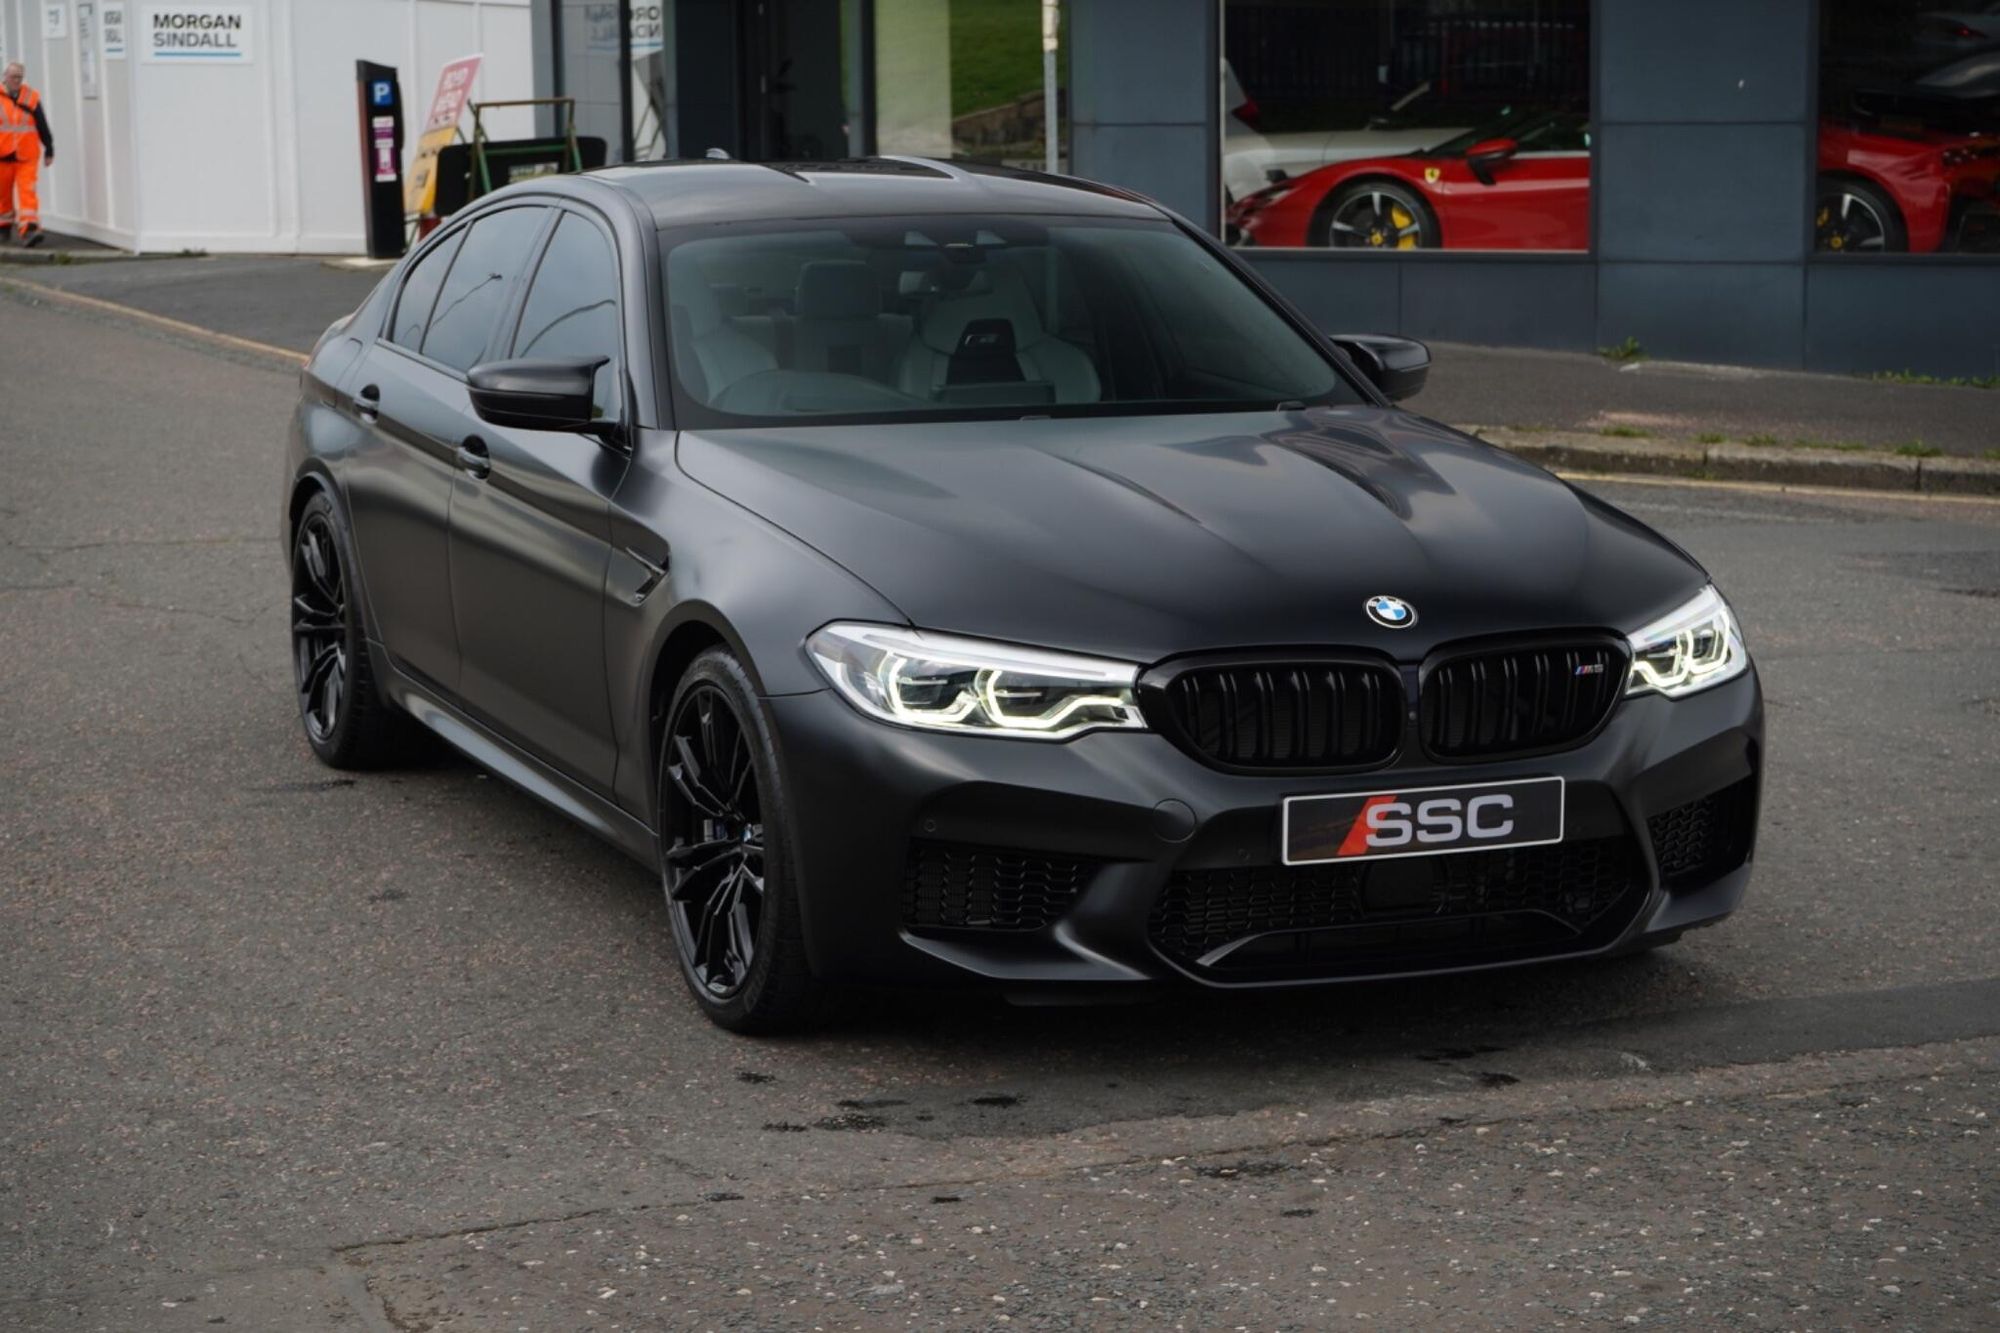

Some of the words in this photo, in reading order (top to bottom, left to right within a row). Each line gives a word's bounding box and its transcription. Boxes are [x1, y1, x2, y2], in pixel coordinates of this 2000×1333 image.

[153, 14, 241, 29] MORGAN
[153, 32, 237, 48] SINDALL
[373, 82, 390, 103] P
[1366, 794, 1514, 847] SSC
